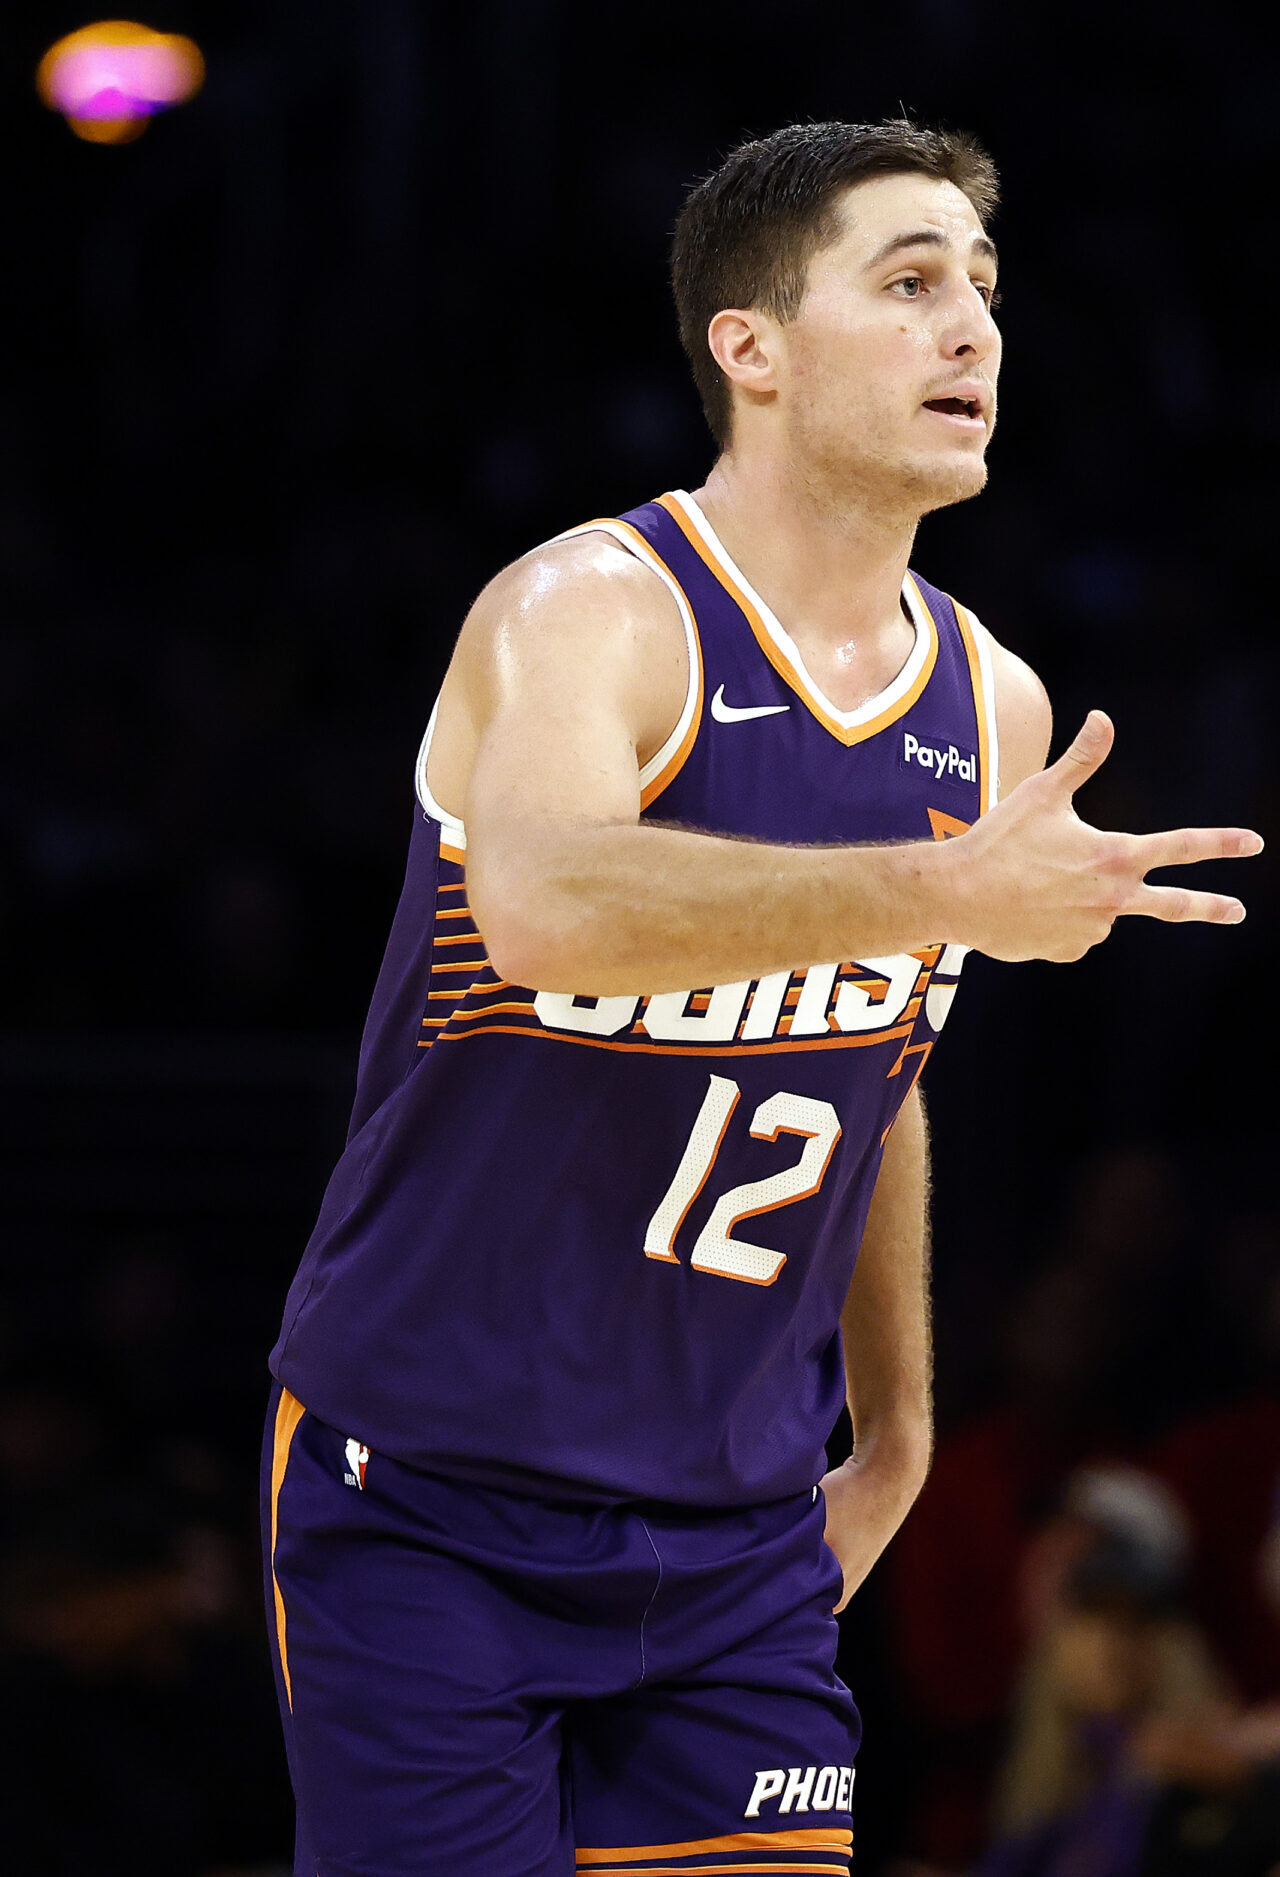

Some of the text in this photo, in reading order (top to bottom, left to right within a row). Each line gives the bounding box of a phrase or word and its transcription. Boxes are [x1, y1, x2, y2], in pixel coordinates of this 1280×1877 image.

[904, 732, 977, 783] PayPal
[644, 1073, 842, 1287] 12
[744, 1766, 856, 1818] PHOE
